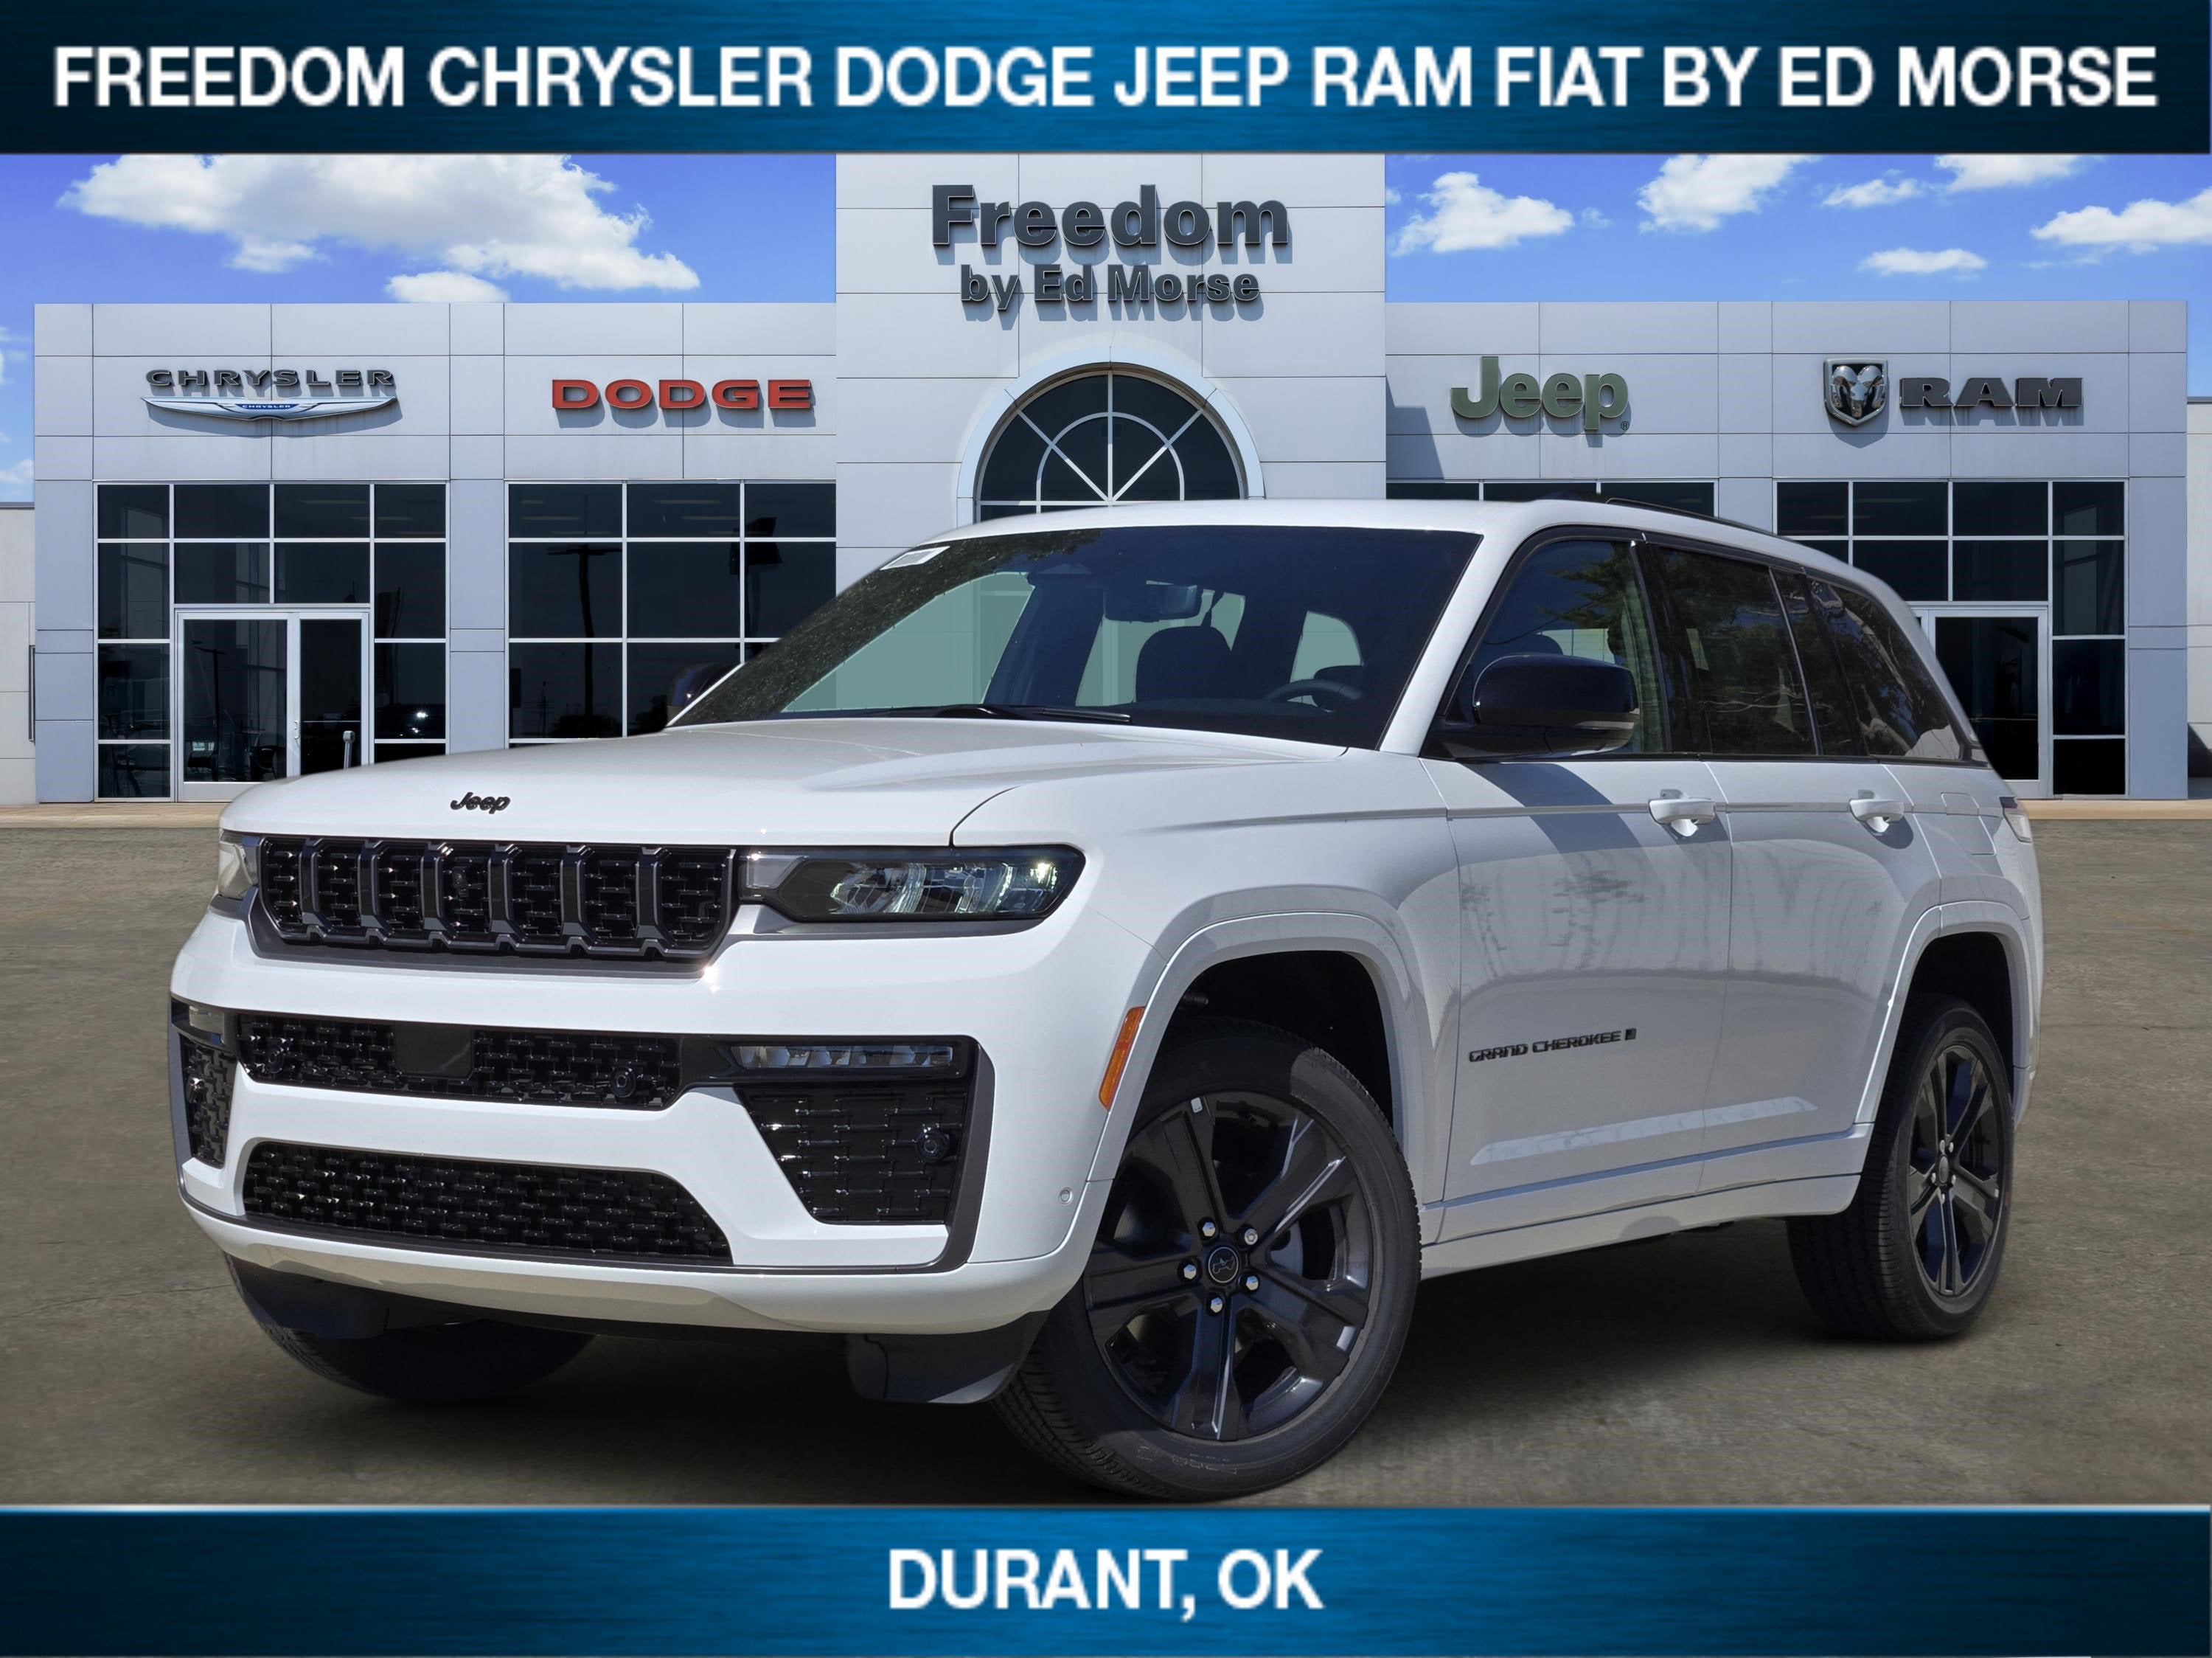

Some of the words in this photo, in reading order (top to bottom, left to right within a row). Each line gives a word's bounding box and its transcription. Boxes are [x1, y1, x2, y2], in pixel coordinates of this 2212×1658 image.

[932, 184, 1288, 246] Freedom
[961, 264, 1019, 311] by
[1034, 264, 1093, 302] Ed
[1107, 264, 1260, 302] Morse
[146, 370, 394, 386] CHRYSLER
[1450, 356, 1629, 430] Jeep
[1899, 378, 2083, 407] RAM
[552, 379, 811, 409] DODGE
[450, 791, 510, 814] Jeep
[1469, 1043, 1528, 1062] GRAND
[1532, 1030, 1621, 1053] CHEROKEE
